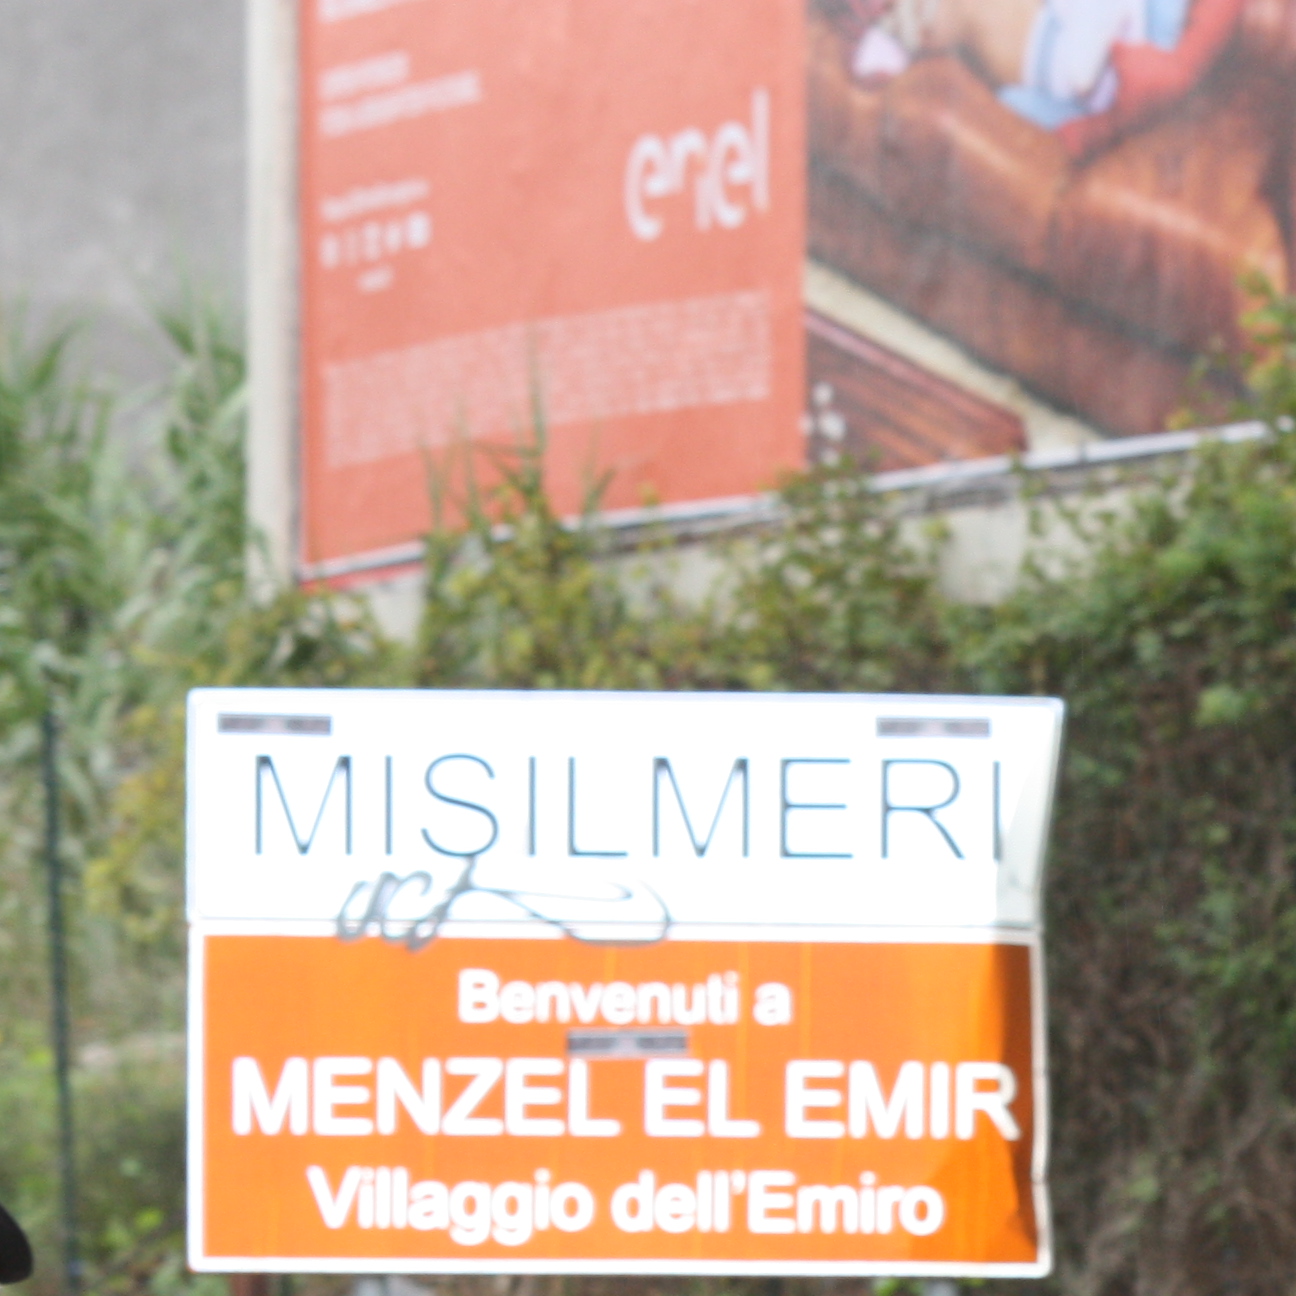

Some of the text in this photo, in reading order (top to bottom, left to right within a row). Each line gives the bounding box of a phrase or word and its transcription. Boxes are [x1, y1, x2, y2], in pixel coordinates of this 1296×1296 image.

[623, 85, 771, 242] enel
[253, 752, 1004, 863] MISILMERI
[456, 968, 795, 1027] Benvenuti a
[230, 1055, 1023, 1143] MENZEL EL EMIR
[305, 1165, 947, 1247] Villaggio dell'Emiro
